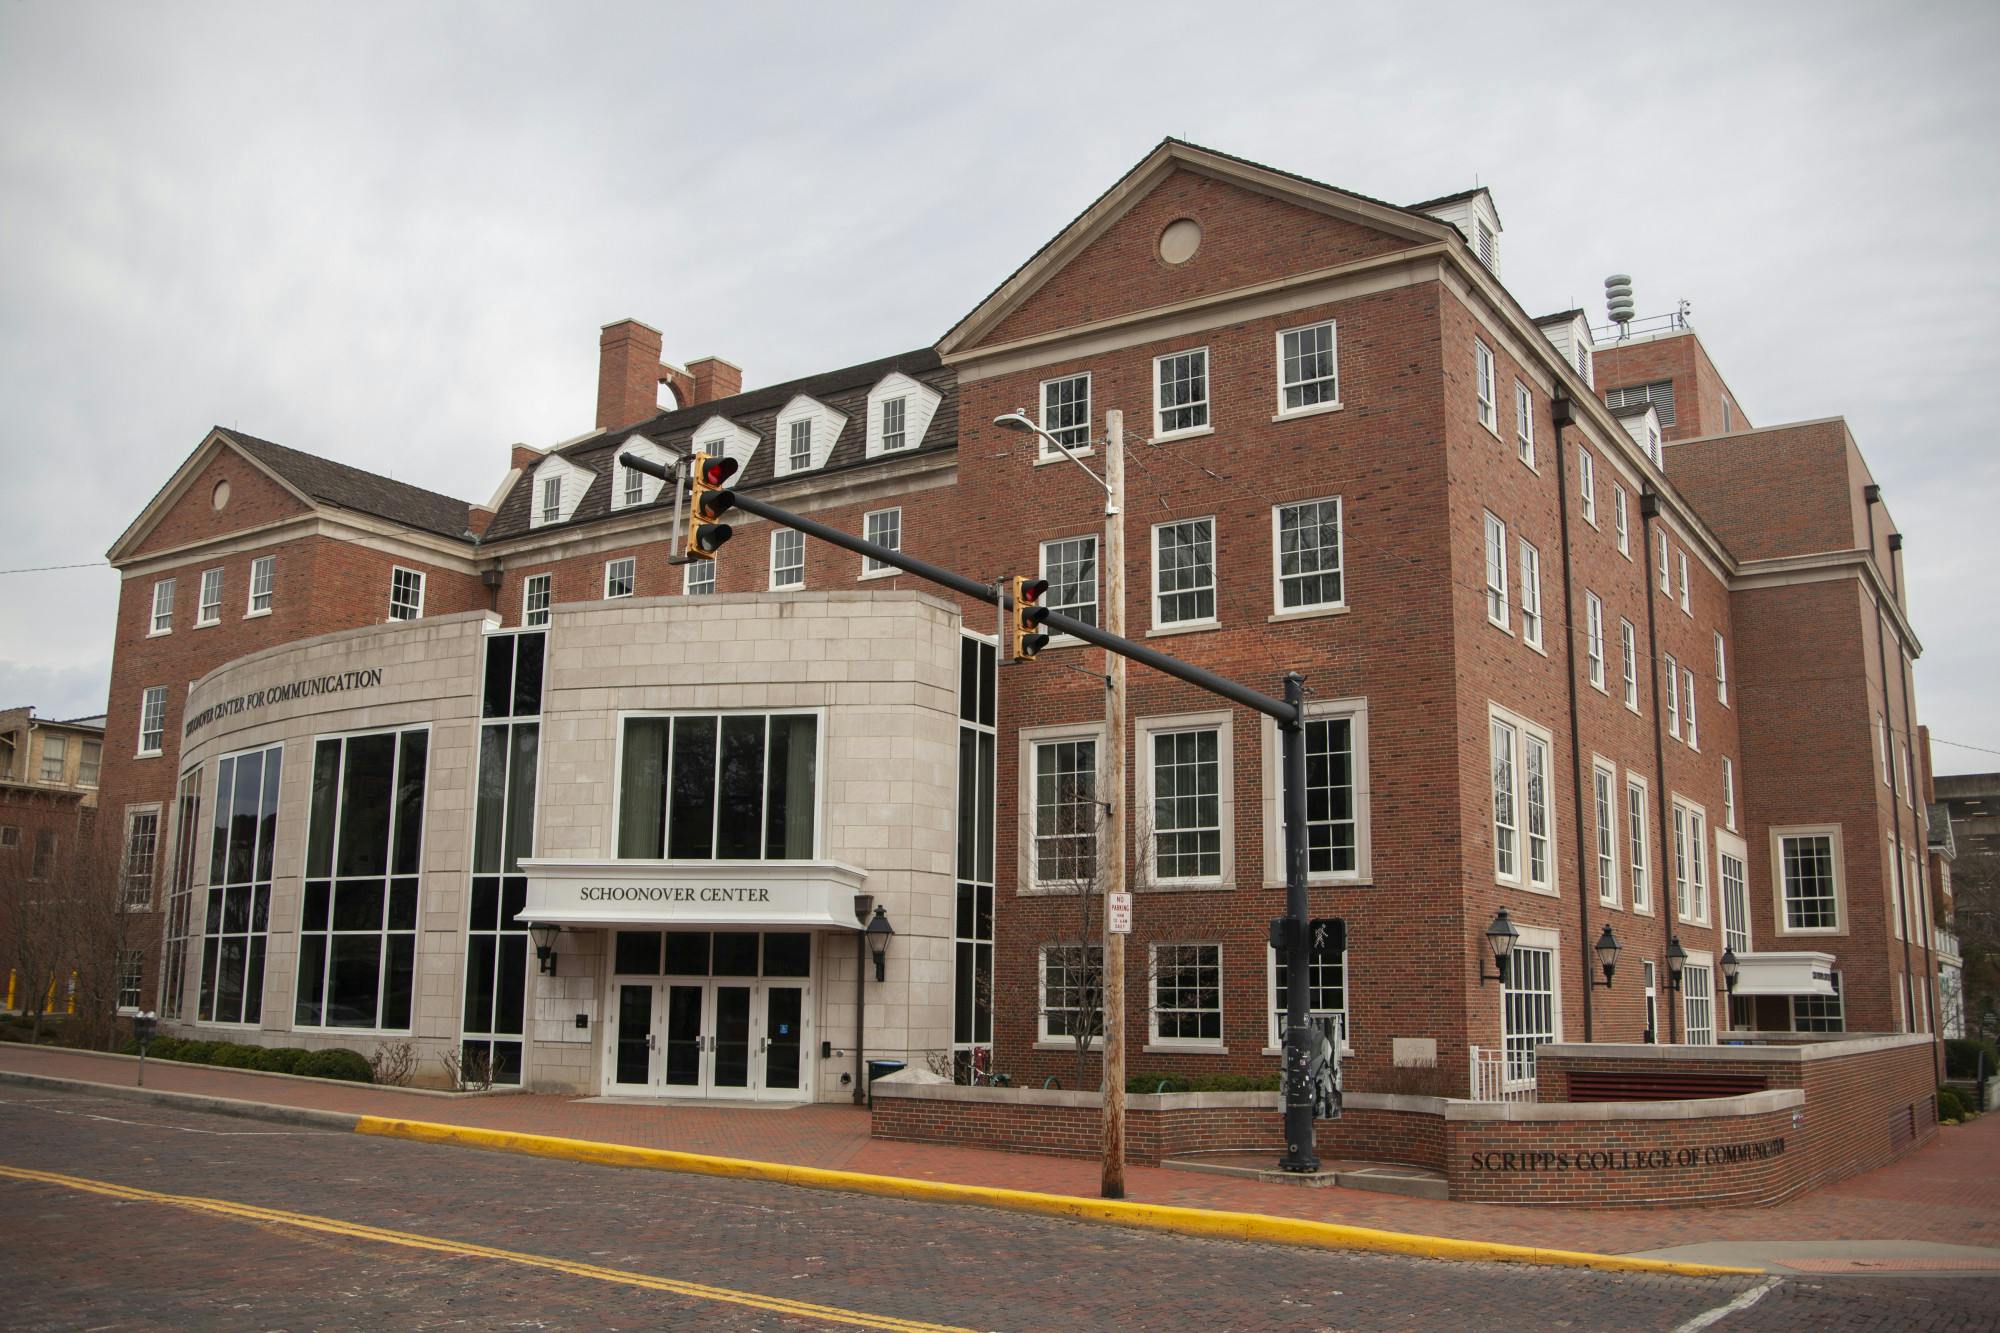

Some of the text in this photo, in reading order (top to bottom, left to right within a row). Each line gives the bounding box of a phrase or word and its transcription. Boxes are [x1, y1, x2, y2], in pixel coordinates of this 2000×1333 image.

[214, 697, 245, 720] CENTER
[247, 691, 265, 710] FOR
[266, 668, 383, 704] COMMUNICATION
[580, 887, 770, 902] SCHOONOVER CENTER
[1471, 1151, 1569, 1171] SCRIPPS
[1575, 1149, 1674, 1171] COLLEGE
[1677, 1147, 1700, 1168] OF
